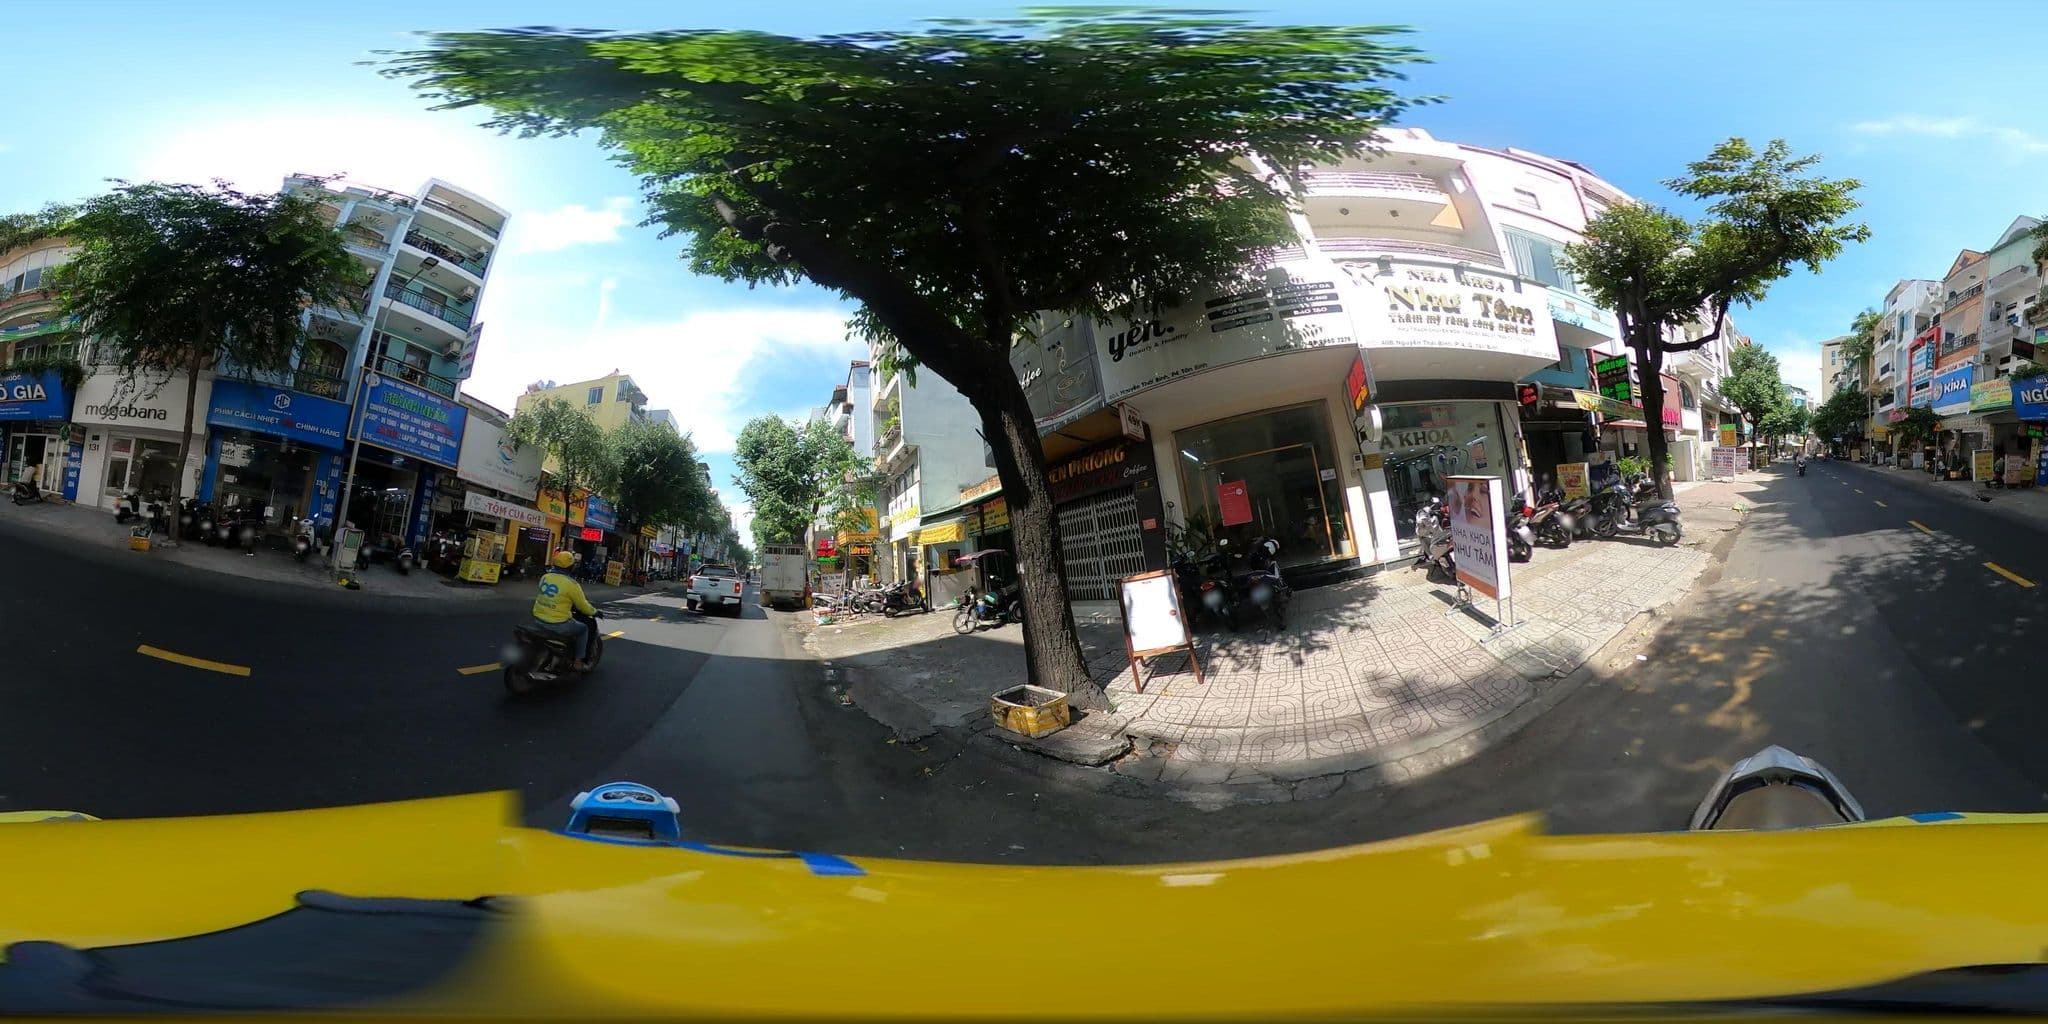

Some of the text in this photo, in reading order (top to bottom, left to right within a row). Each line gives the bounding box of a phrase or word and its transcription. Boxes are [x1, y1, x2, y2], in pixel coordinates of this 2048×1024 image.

[1019, 367, 1042, 390] ffee
[13, 383, 47, 401] GIA
[85, 403, 168, 421] mogabana
